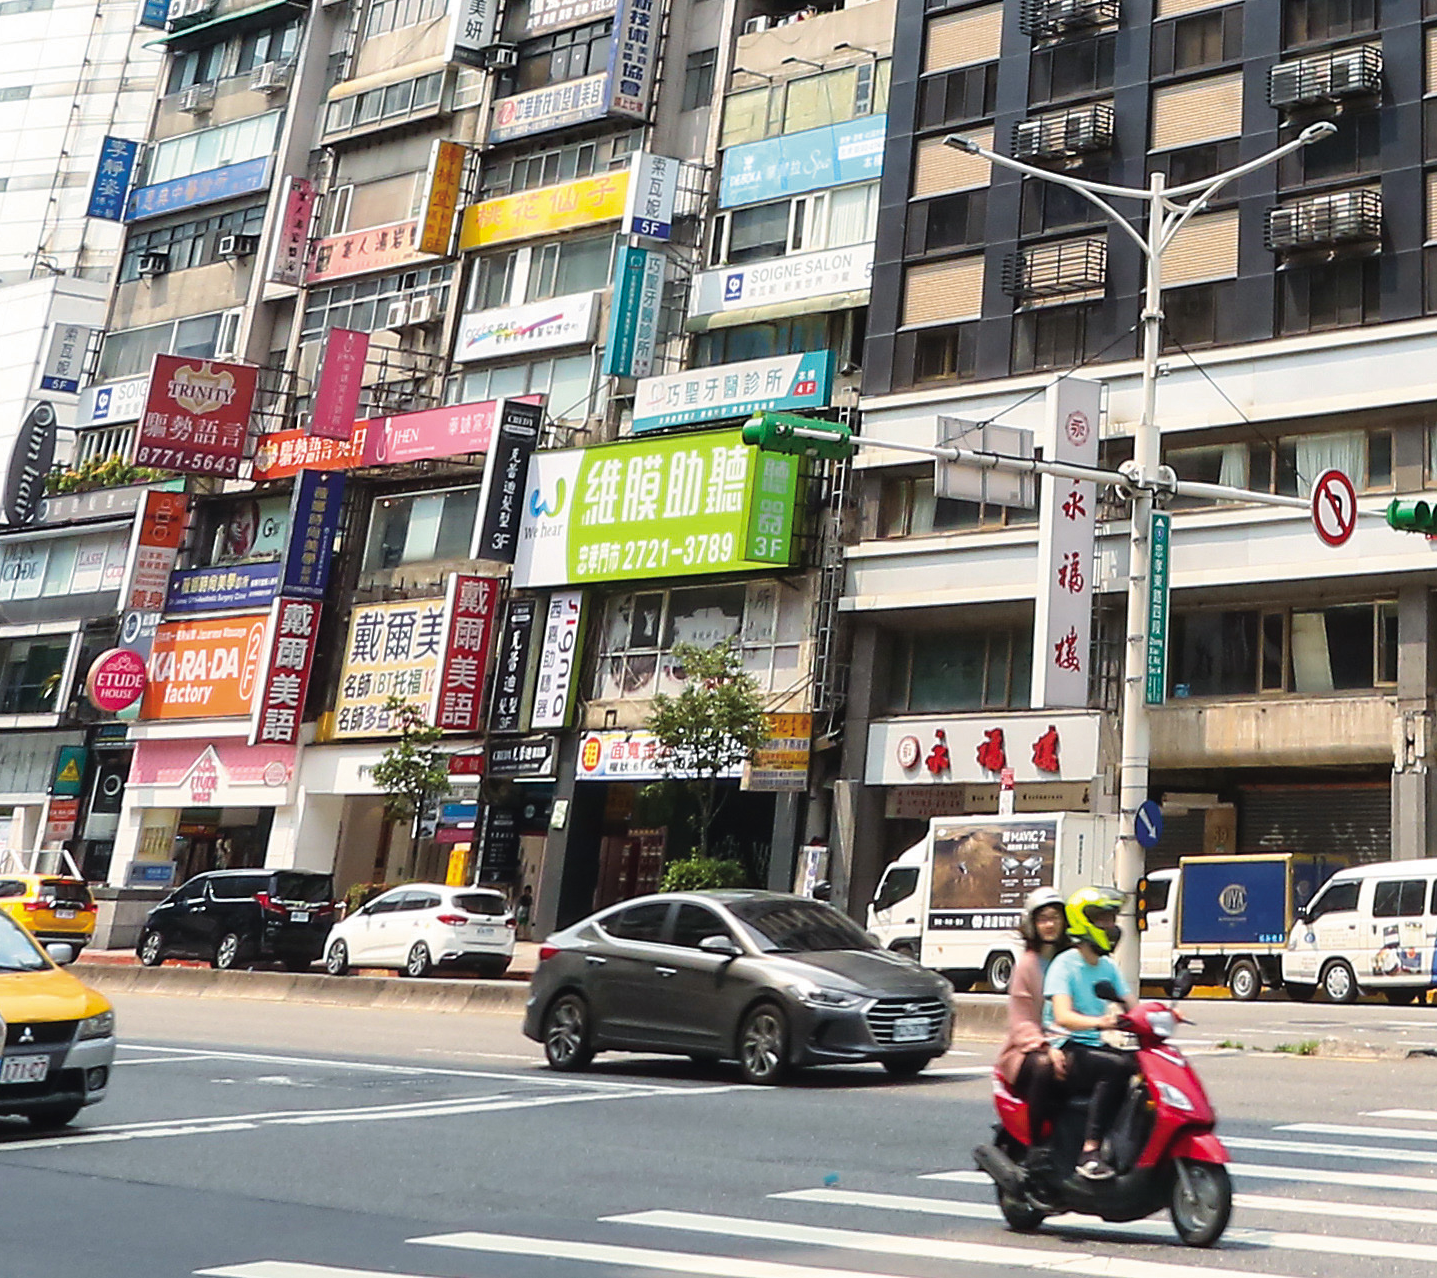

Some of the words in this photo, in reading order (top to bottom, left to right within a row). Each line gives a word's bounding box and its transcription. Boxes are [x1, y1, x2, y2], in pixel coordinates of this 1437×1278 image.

[640, 220, 661, 235] 5F
[168, 379, 236, 406] TRINITY
[137, 446, 239, 474] 8771-5643
[491, 531, 512, 551] 3F
[621, 531, 734, 571] 2721-3789
[754, 537, 783, 558] 3F
[1053, 477, 1087, 674] 永福樓
[439, 579, 491, 727] 戴爾美語
[96, 669, 144, 691] ETUDE
[262, 602, 315, 742] 戴爾美語
[163, 683, 214, 705] factory
